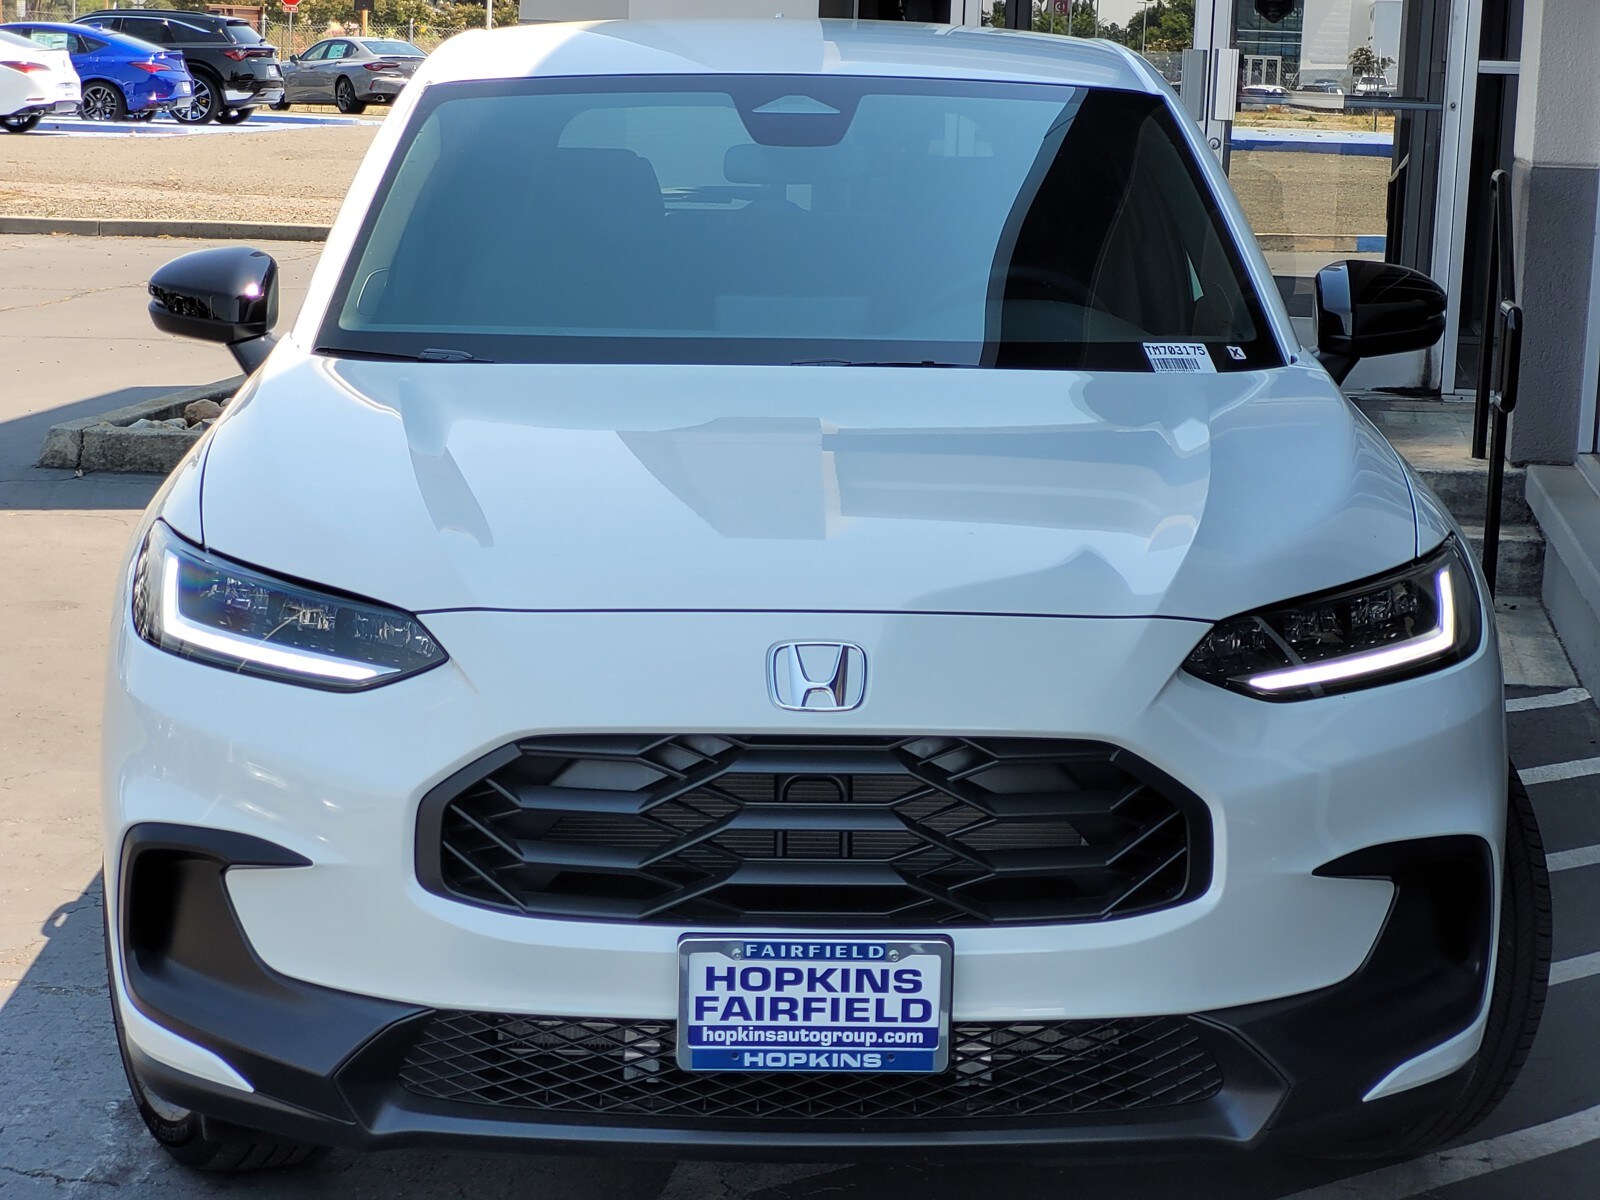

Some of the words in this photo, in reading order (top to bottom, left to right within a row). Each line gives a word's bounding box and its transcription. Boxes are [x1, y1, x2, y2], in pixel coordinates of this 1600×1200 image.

[1144, 345, 1206, 356] TM703175
[745, 944, 885, 959] FAIRFIELD
[705, 966, 923, 994] HOPKINS
[694, 996, 933, 1023] FAIRFIELD
[702, 1027, 924, 1047] hopkinsautogroup.com
[743, 1052, 882, 1068] HOPKINS
